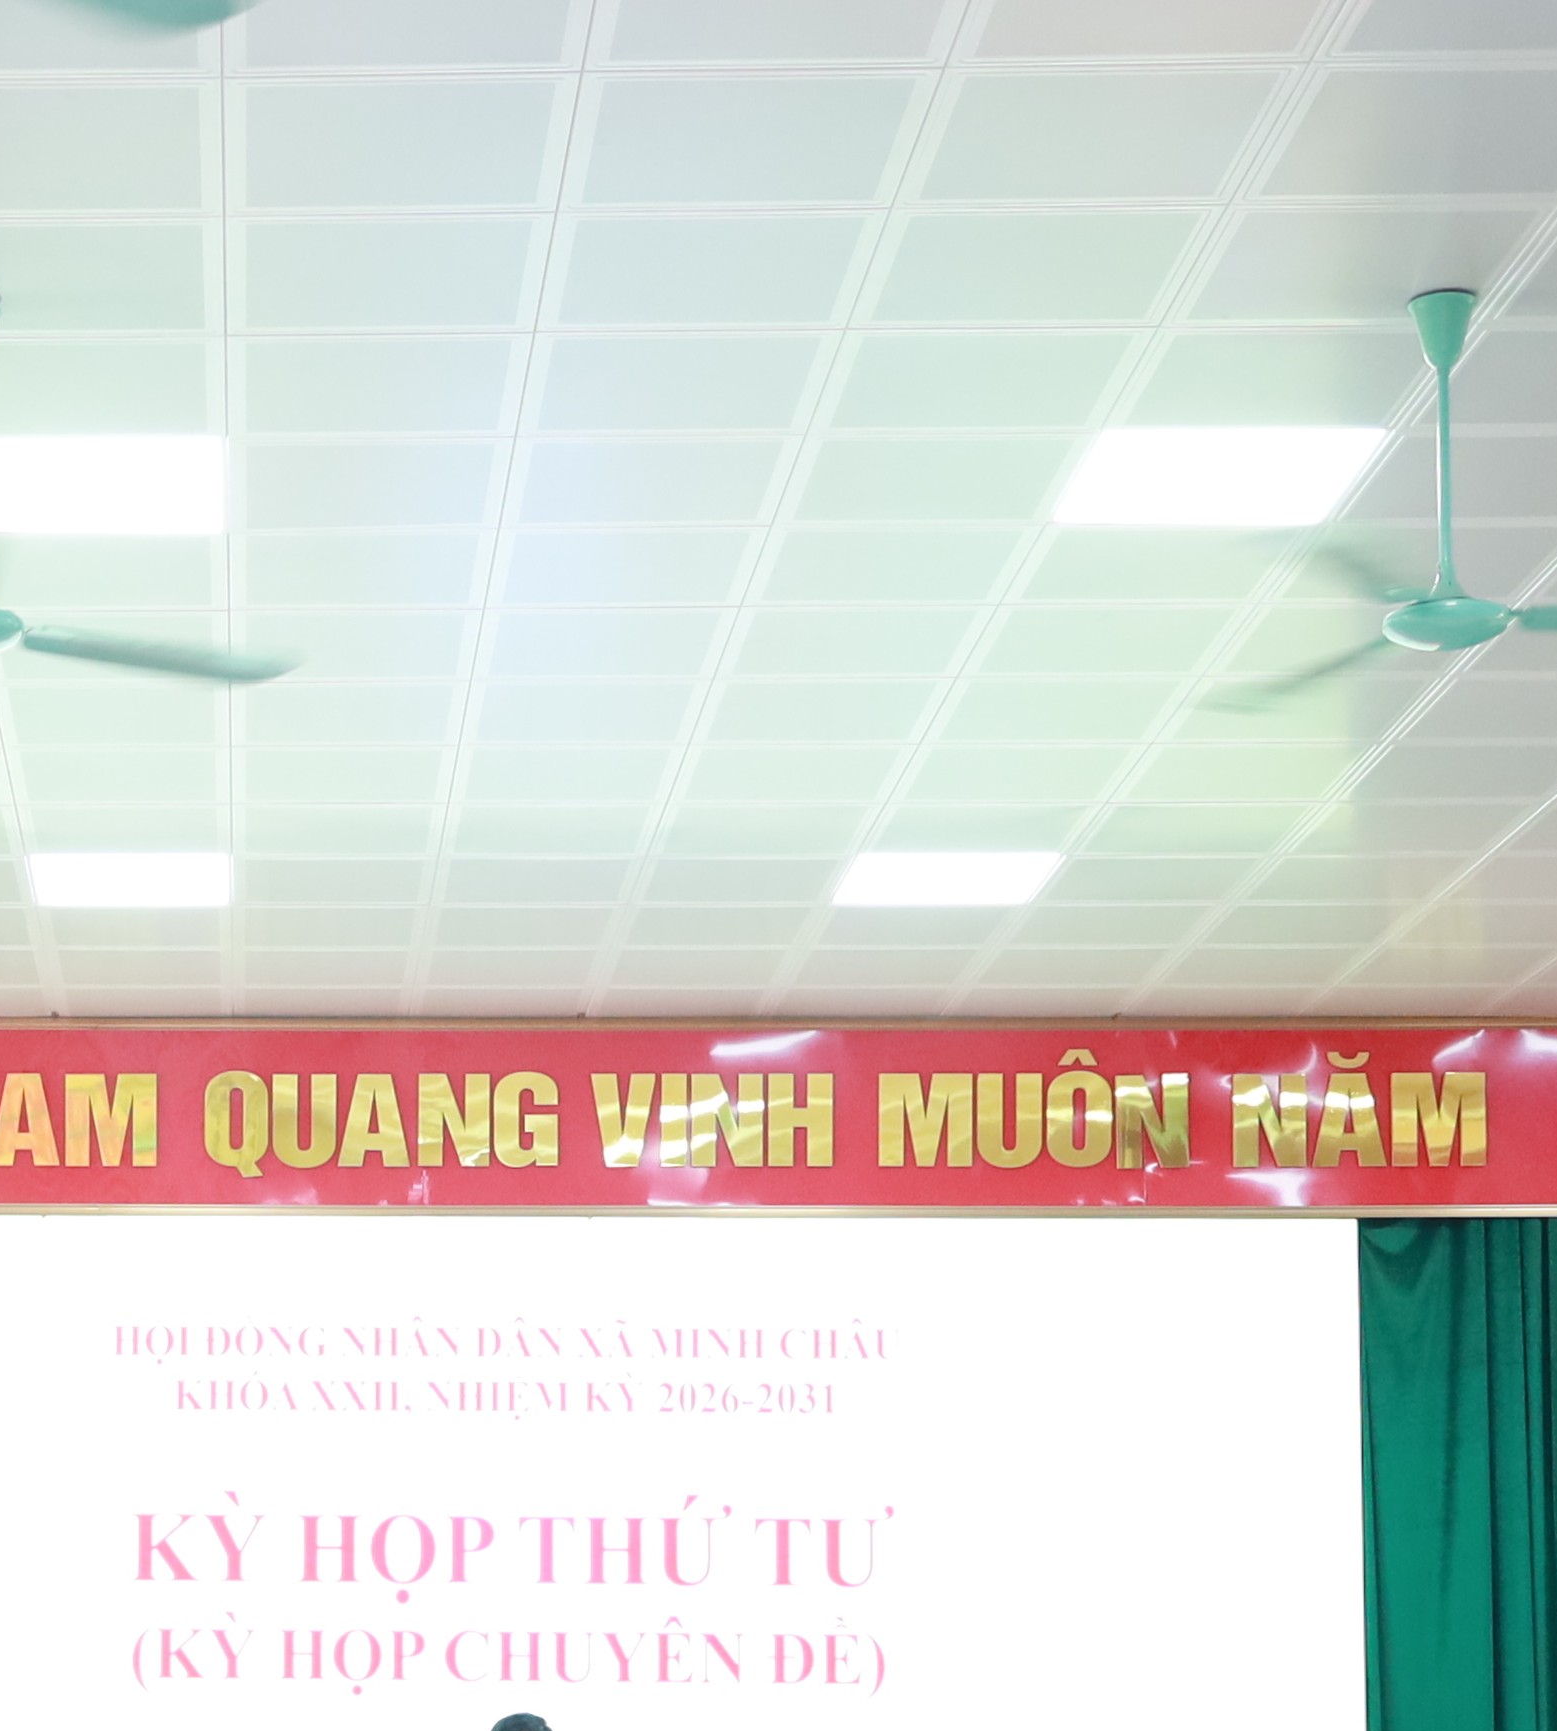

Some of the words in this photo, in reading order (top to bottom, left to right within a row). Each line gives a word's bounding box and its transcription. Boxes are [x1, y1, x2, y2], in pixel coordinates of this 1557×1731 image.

[205, 1072, 558, 1176] QUANG
[593, 1074, 833, 1165] VINH
[879, 1051, 1188, 1168] MUÔN
[1234, 1054, 1486, 1166] NĂM
[343, 1316, 458, 1357] NHÂN
[478, 1317, 560, 1357] DÂN
[579, 1320, 633, 1358] XÃ
[652, 1328, 763, 1358] MINH
[779, 1316, 898, 1360] CHÂU
[177, 1371, 297, 1410] KHÓA
[313, 1381, 411, 1412] XXII,
[659, 1382, 833, 1414] 2026-2031
[135, 1491, 264, 1582] KỲ
[300, 1515, 495, 1604] HỌP
[519, 1494, 732, 1586] THỨ
[755, 1505, 894, 1588] TƯ
[132, 1611, 254, 1690] (KỲ
[282, 1629, 425, 1696] HỌP
[444, 1615, 744, 1683] CHUYÊN
[769, 1616, 887, 1697] ĐỀ)
